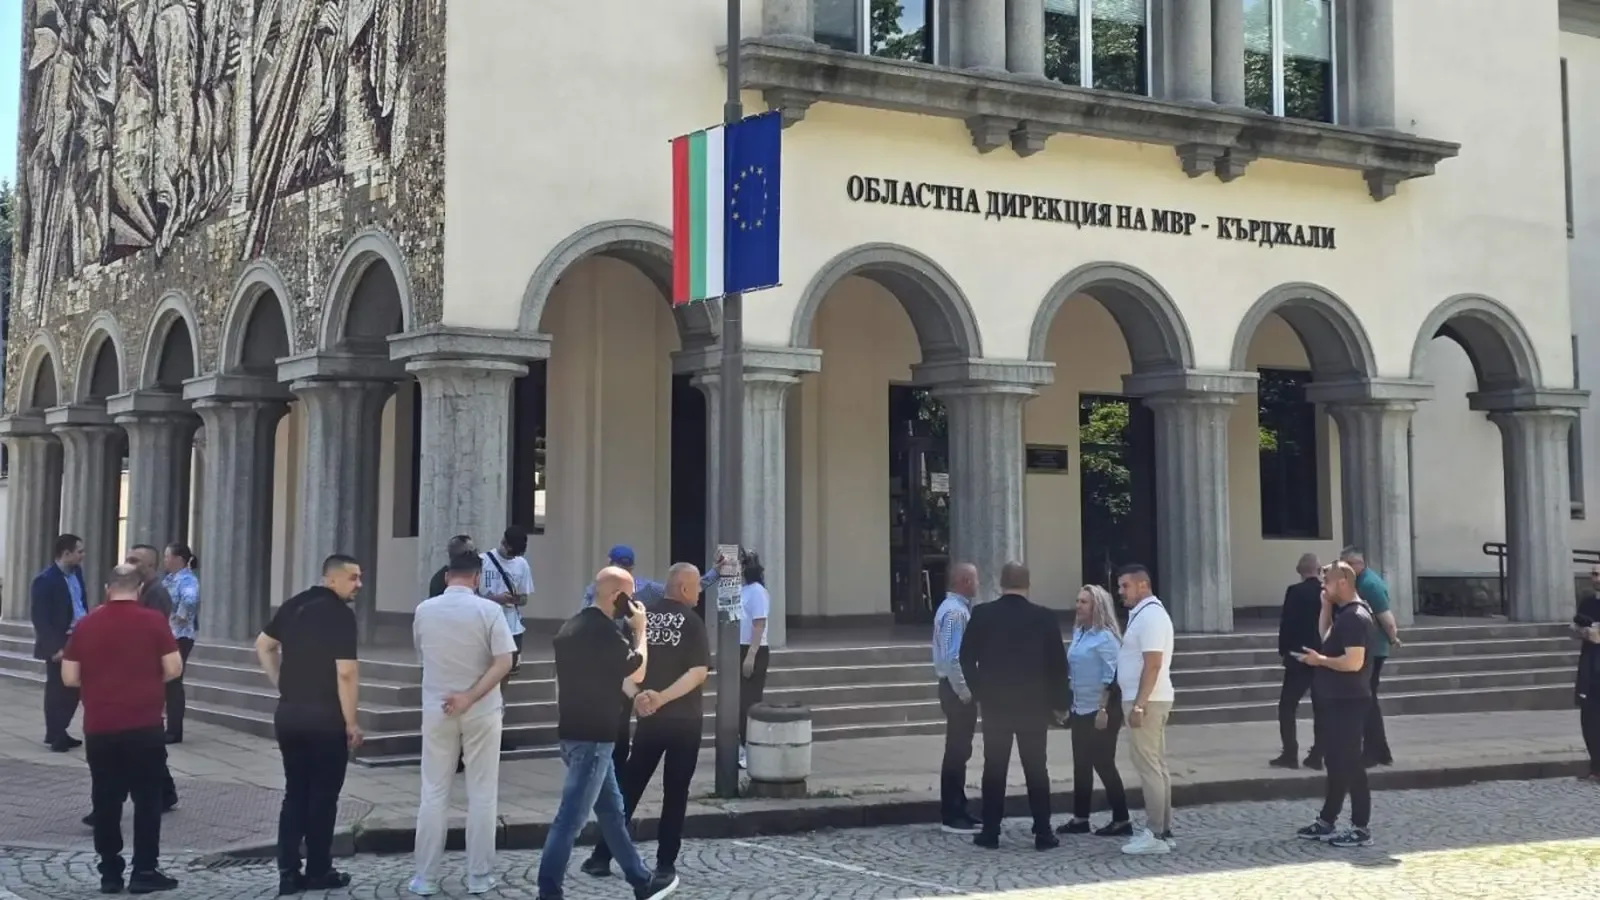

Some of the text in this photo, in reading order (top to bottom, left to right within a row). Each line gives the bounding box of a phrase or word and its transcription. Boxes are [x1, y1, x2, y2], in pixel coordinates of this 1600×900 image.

[847, 174, 981, 213] ОБЛАСТНА
[985, 190, 1112, 230] ДИРЕКЦИЯ
[1116, 204, 1147, 231] НА
[1151, 208, 1196, 236] МВР
[1216, 215, 1337, 250] КЪРДЖАЛИ
